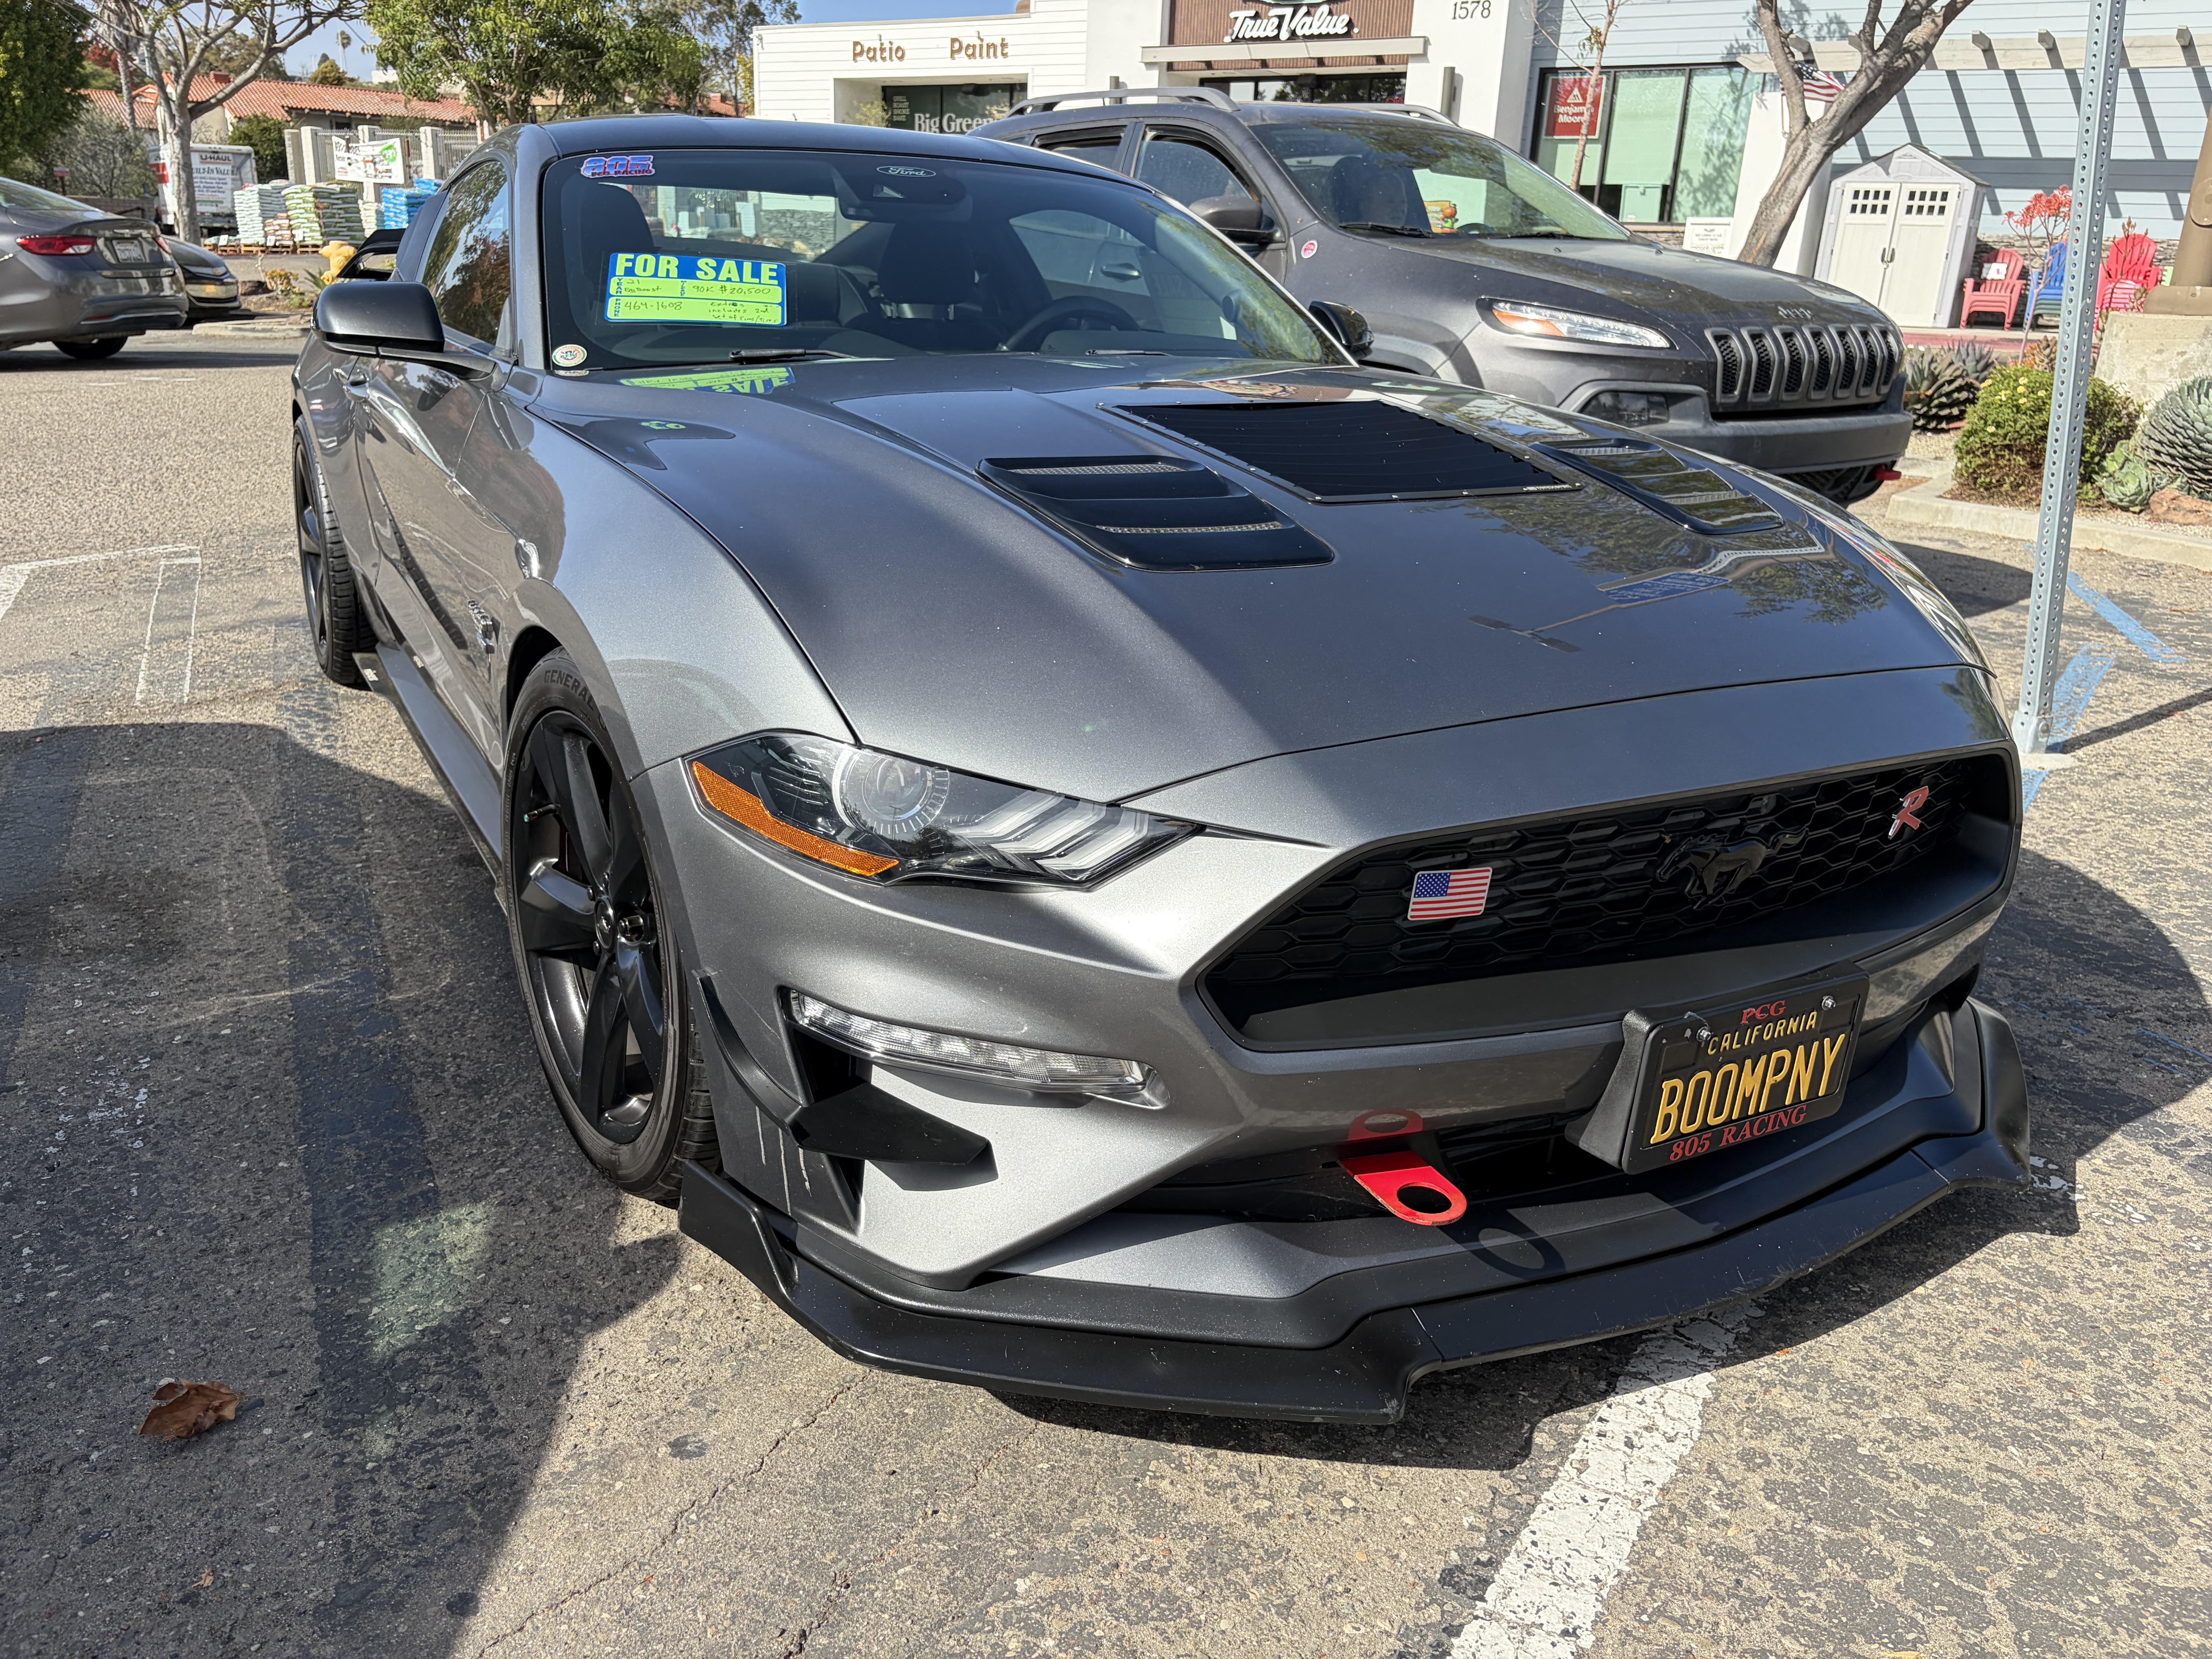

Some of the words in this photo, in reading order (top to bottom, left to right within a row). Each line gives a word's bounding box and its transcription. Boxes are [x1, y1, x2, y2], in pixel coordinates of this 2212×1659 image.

[1451, 0, 1491, 20] 1578
[1223, 10, 1279, 43] True
[1268, 4, 1350, 41] Value
[852, 40, 906, 62] Patio
[950, 37, 1008, 60] Paint
[1554, 103, 1594, 115] Benjamn
[584, 156, 652, 176] 805
[888, 167, 926, 176] Ford
[615, 254, 679, 278] FOR
[696, 258, 778, 285] SALE
[615, 278, 623, 294] YEAR
[718, 284, 771, 295] $20,500
[624, 301, 683, 311] 464-1608
[544, 670, 594, 711] GENERAL
[1740, 1000, 1786, 1024] PCG
[1707, 1011, 1817, 1055] CALIFORNIA
[1650, 1033, 1846, 1144] BOOMPNY
[1669, 1133, 1712, 1161] 805
[1719, 1104, 1807, 1147] RACING
